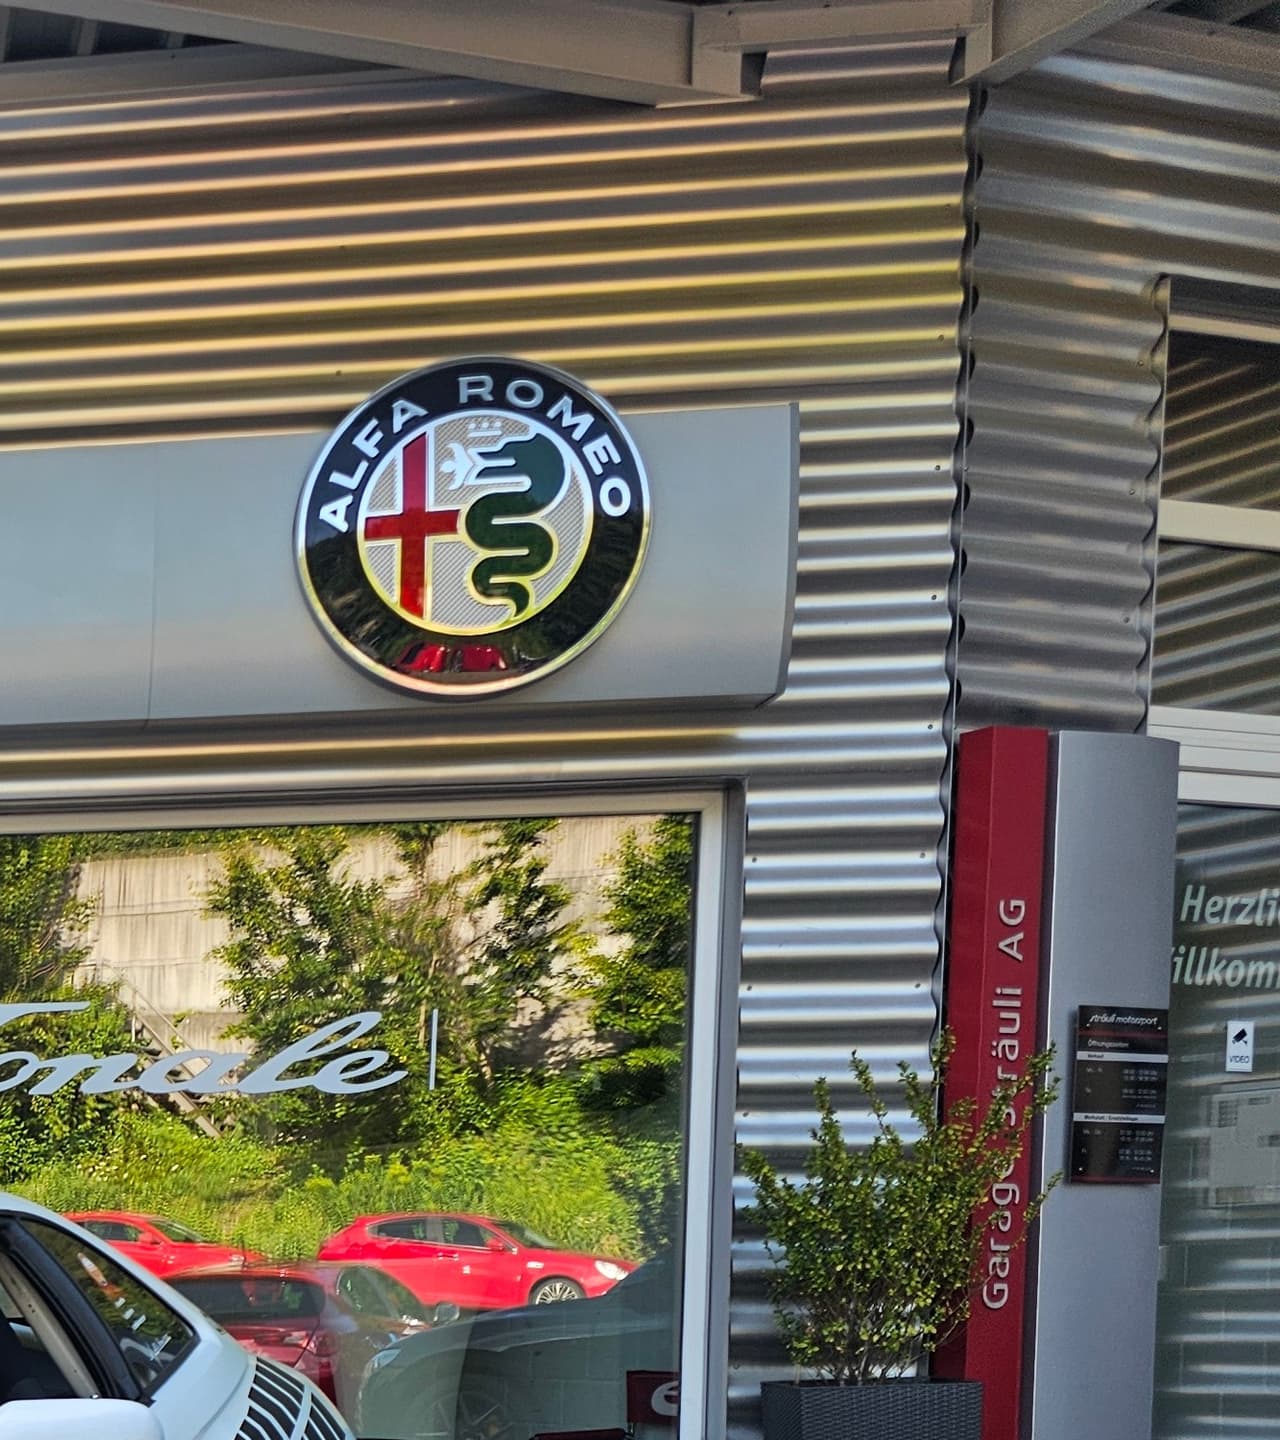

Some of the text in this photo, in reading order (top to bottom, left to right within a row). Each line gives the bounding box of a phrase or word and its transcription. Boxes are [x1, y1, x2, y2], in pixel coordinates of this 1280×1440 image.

[320, 375, 631, 532] ALFA ROMEO
[1180, 884, 1280, 927] Herzli
[998, 899, 1026, 962] AG
[1170, 945, 1280, 988] illkom
[1229, 1055, 1250, 1065] VIDEO
